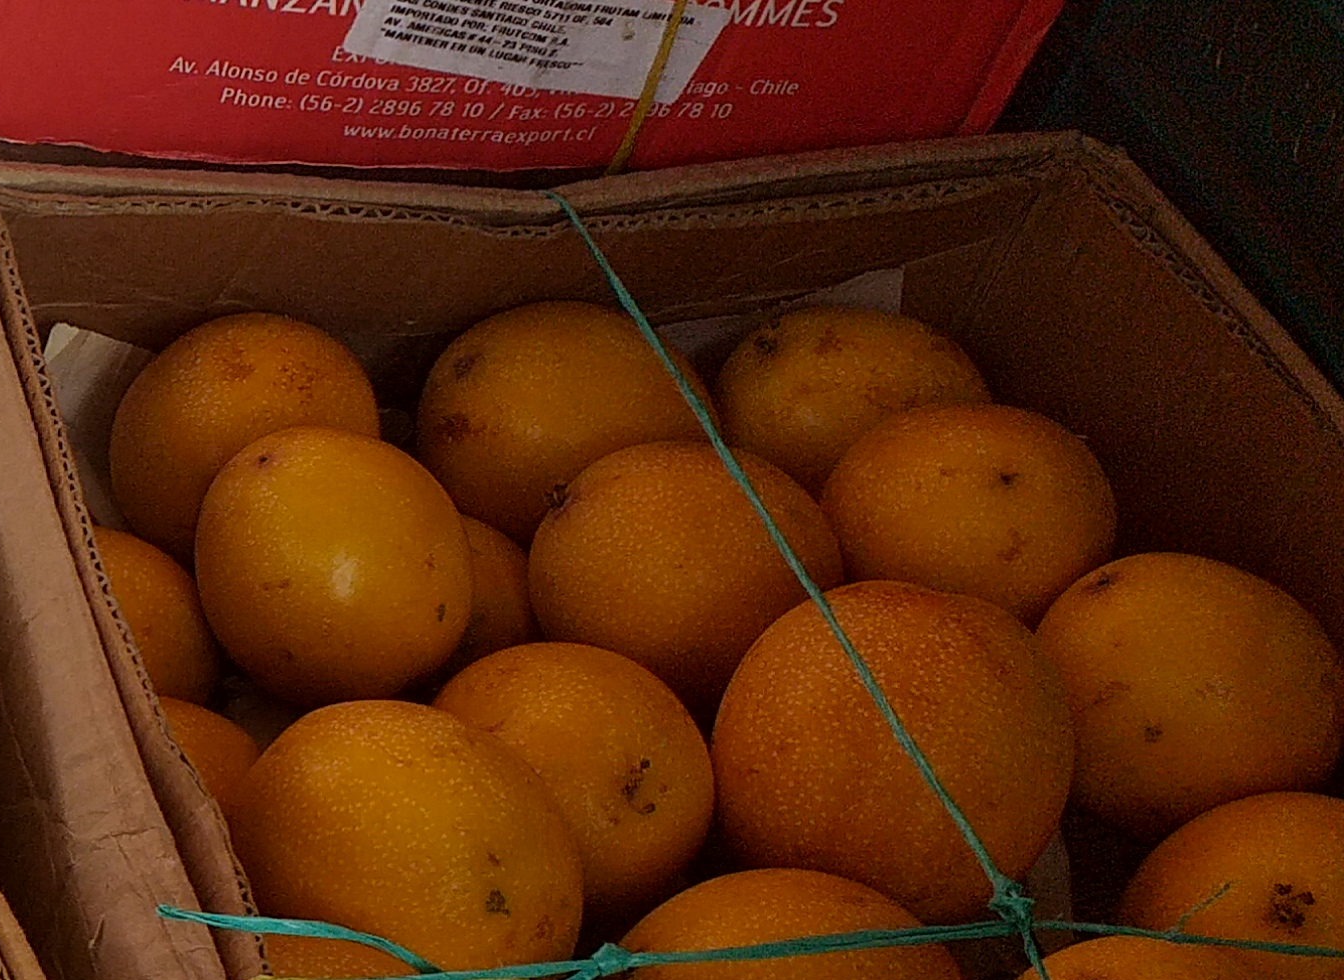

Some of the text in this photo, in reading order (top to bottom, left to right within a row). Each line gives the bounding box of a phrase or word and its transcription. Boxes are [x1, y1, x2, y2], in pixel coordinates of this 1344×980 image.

[389, 5, 460, 26] IMPORTADO
[169, 56, 199, 75] Av.
[205, 60, 278, 84] Alonso
[284, 67, 311, 86] de
[316, 69, 401, 92] Córdova
[463, 78, 492, 96] Of.
[749, 78, 800, 96] Chile
[220, 87, 294, 111] Phone:
[299, 93, 365, 115] (56-2)
[369, 97, 422, 118] 2896
[427, 100, 456, 118] 78
[462, 101, 485, 119] 10
[511, 103, 548, 120] Fax:
[553, 102, 615, 121] (56-2)
[676, 102, 701, 118] 78
[710, 102, 734, 119] 10
[342, 123, 600, 146] www.bonaterraexport.cl
